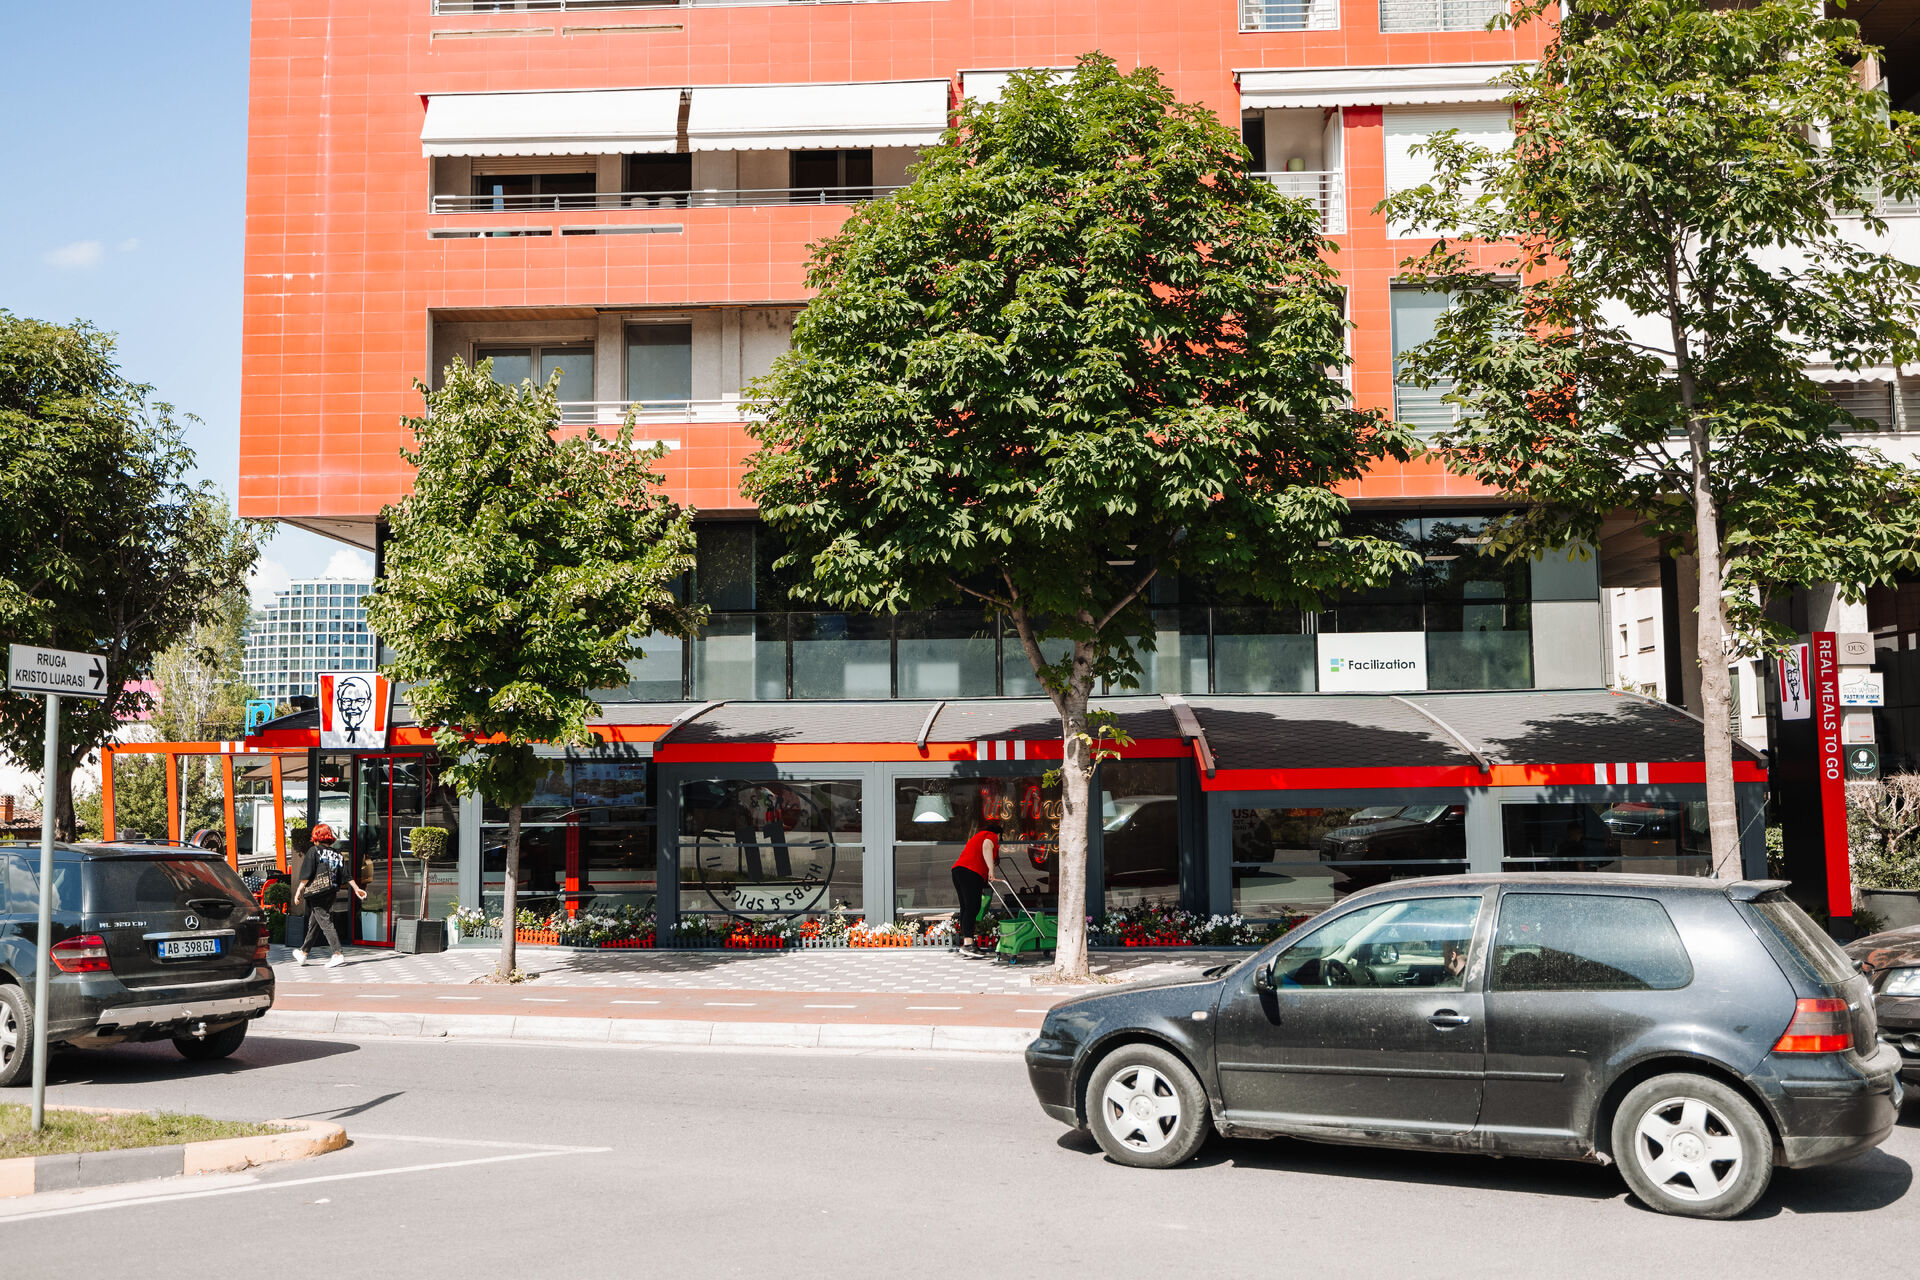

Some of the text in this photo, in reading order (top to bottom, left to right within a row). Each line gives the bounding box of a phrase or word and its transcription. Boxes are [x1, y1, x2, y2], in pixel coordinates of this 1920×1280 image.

[37, 653, 67, 668] RRUGA
[1348, 659, 1416, 670] Facilization
[16, 669, 85, 687] KRISTO LUARASI
[1819, 640, 1839, 780] REAL MEALS TO GO
[1232, 808, 1258, 819] USA
[168, 942, 179, 954] AB
